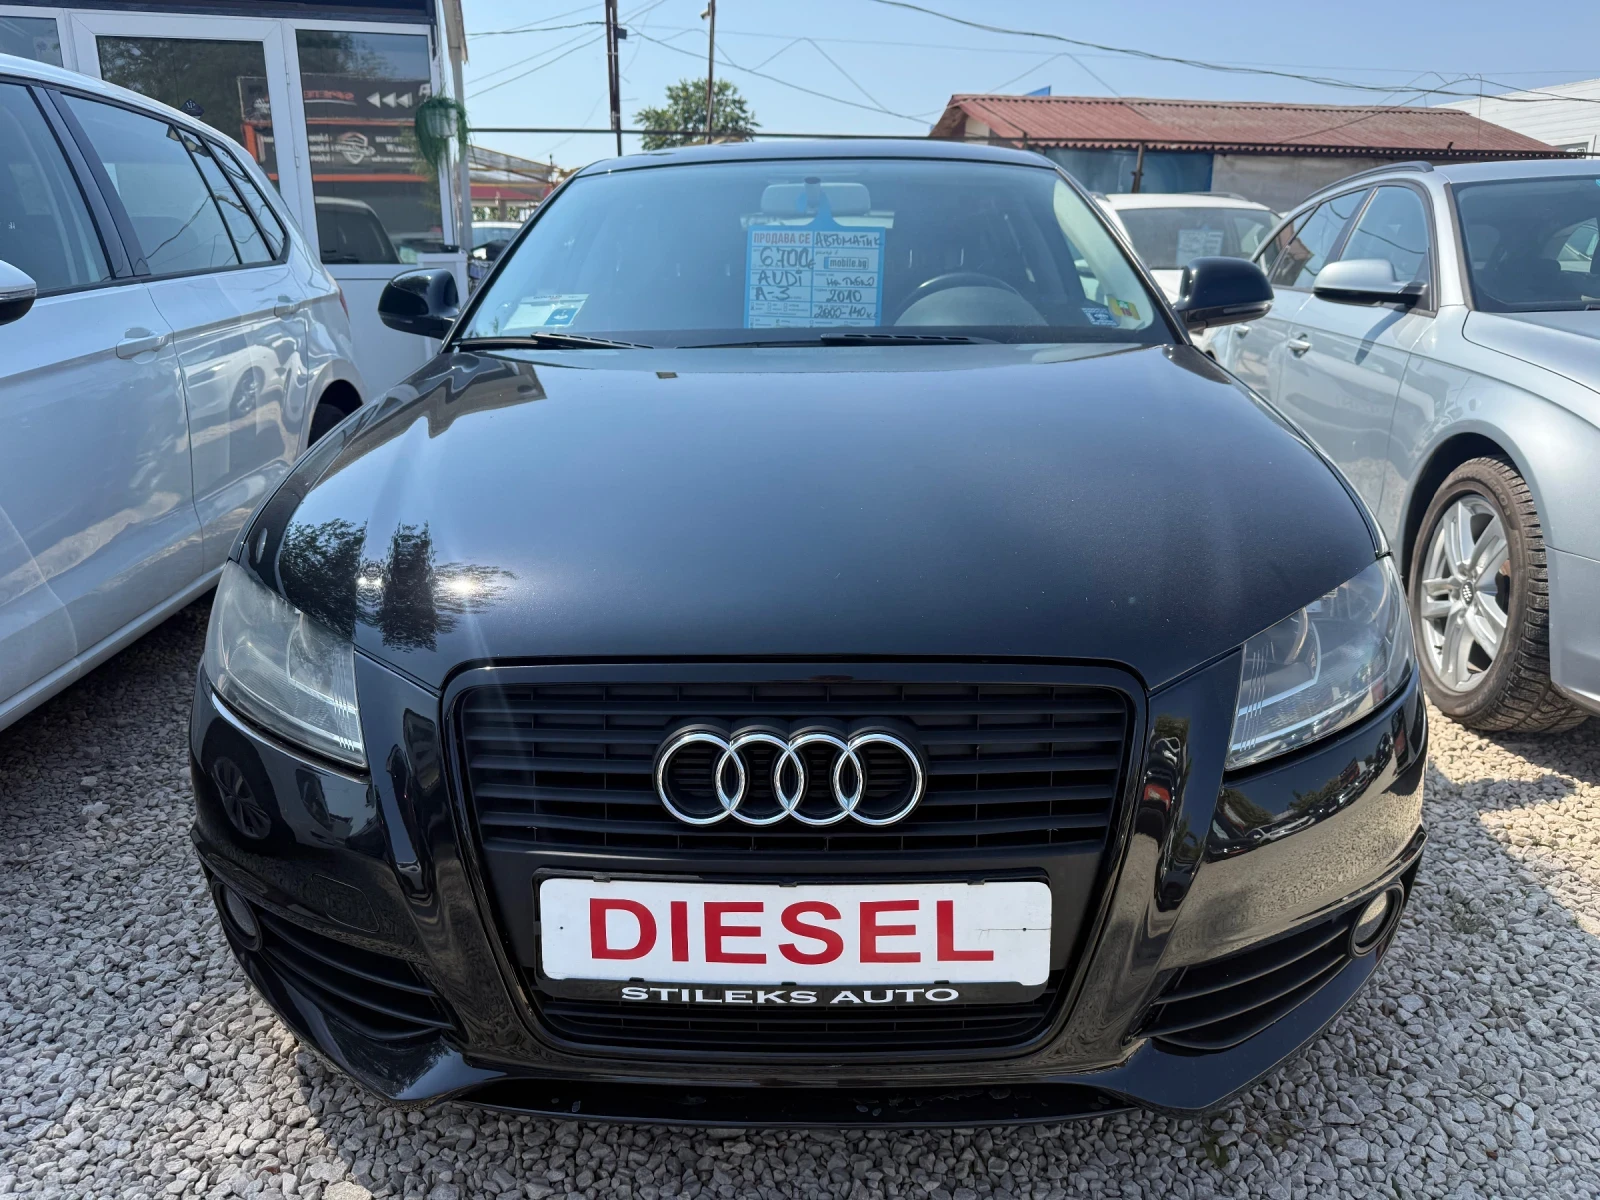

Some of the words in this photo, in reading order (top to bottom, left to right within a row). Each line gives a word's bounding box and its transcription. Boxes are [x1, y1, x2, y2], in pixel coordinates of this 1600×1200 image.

[754, 232, 796, 244] ПРОДАВА
[799, 233, 811, 244] СЕ
[830, 258, 867, 268] mobile.bg
[755, 286, 790, 301] A-3
[826, 289, 862, 303] 2010
[590, 898, 994, 965] DIESEL
[621, 986, 818, 1004] STILEKS
[829, 988, 959, 1004] AUTO
